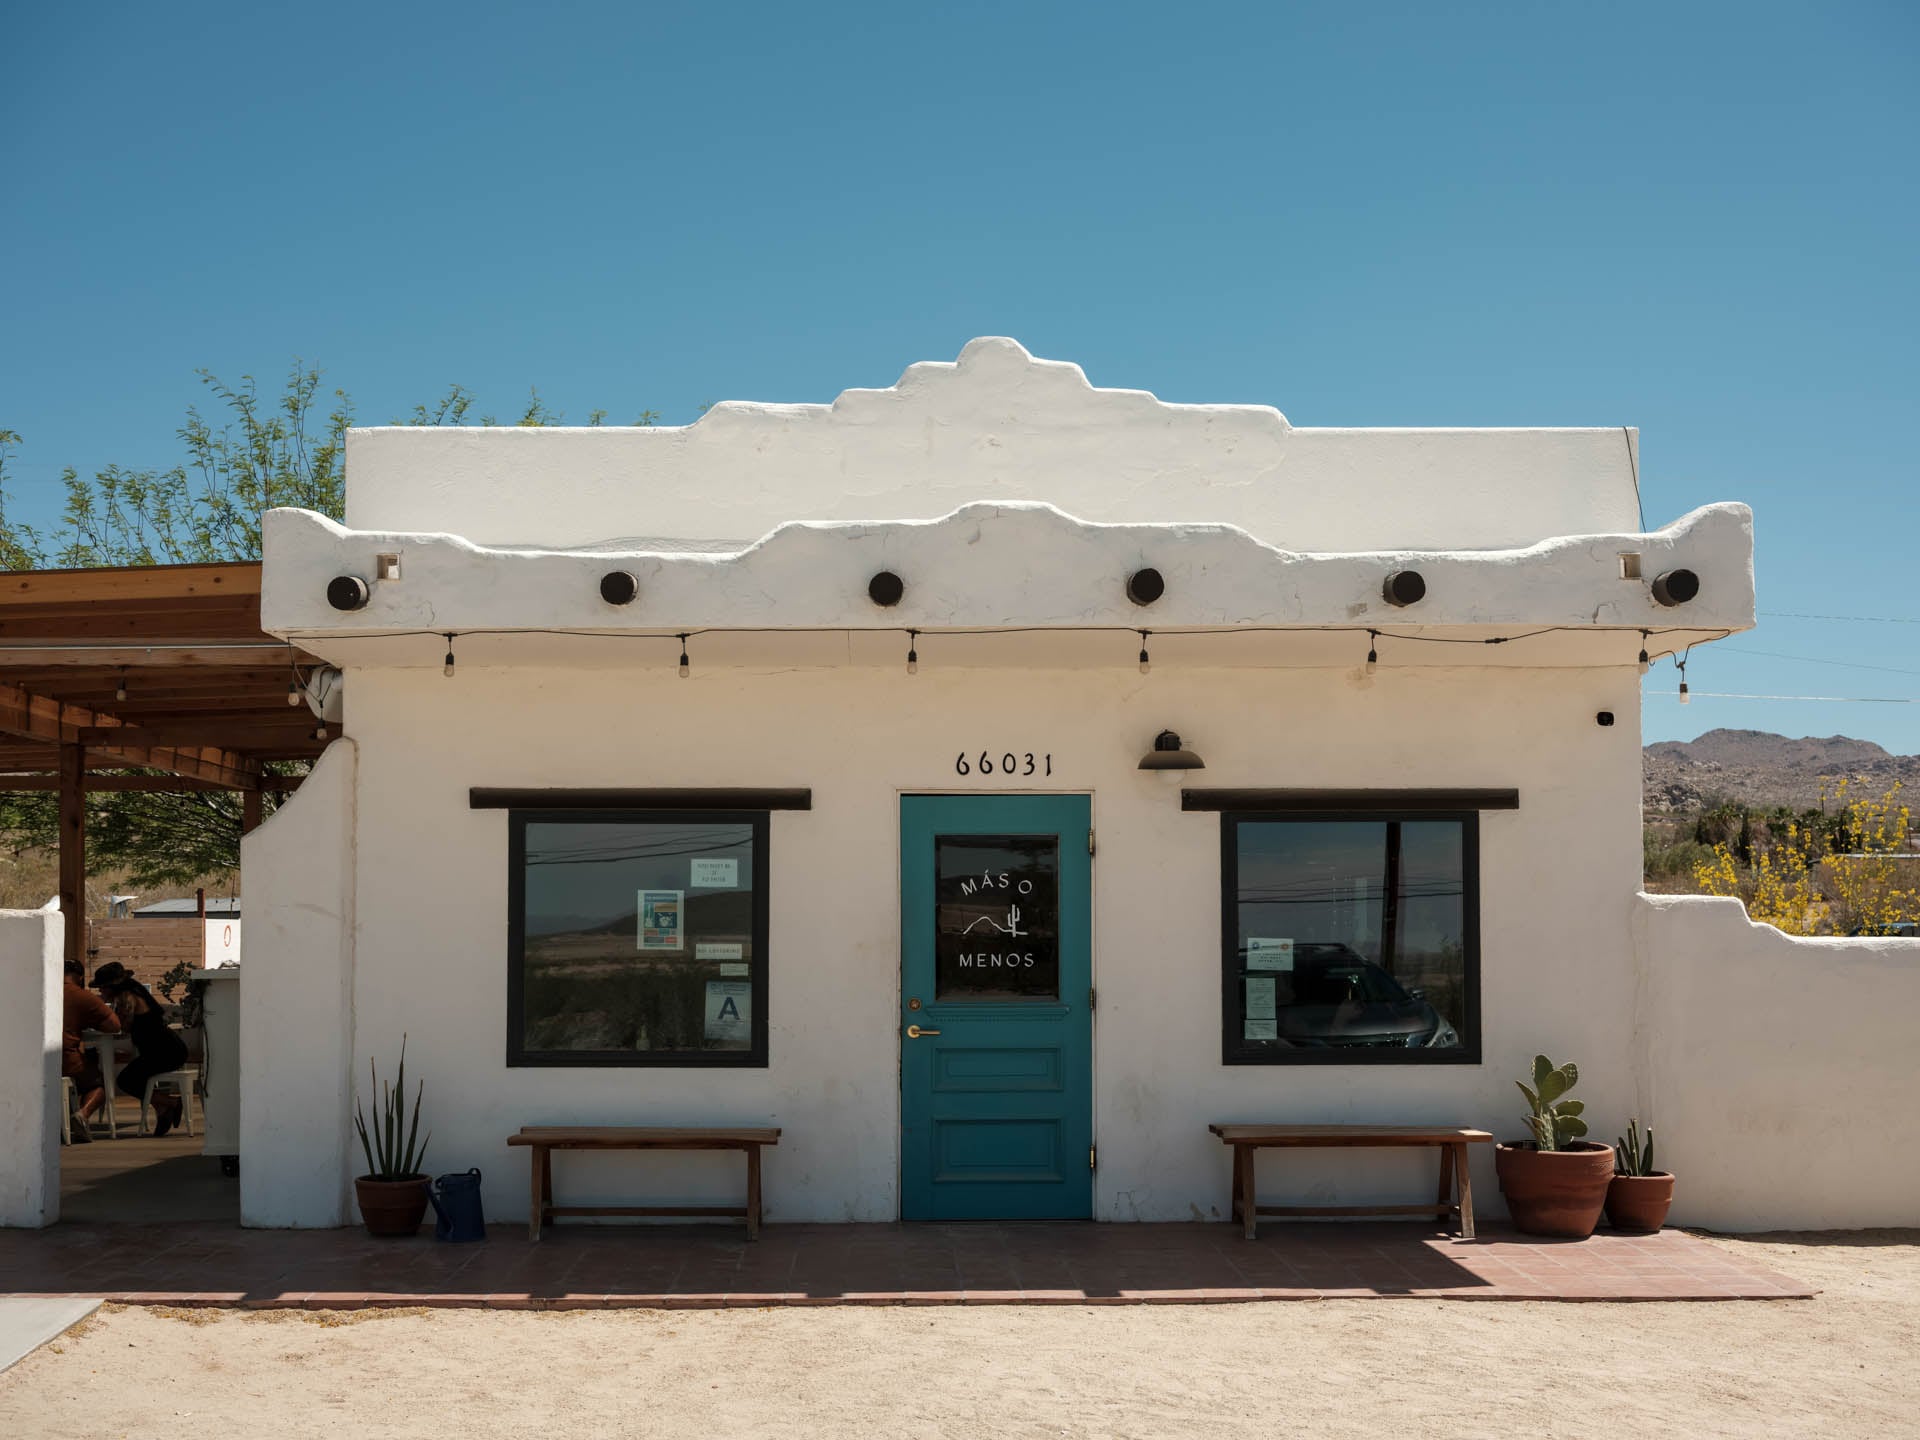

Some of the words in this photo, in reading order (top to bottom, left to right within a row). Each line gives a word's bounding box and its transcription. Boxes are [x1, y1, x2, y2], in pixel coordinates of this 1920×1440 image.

[956, 751, 1051, 776] 66031
[961, 869, 1010, 896] MÁS
[1018, 880, 1032, 894] O
[959, 953, 1034, 967] MENOS
[718, 996, 740, 1020] A
